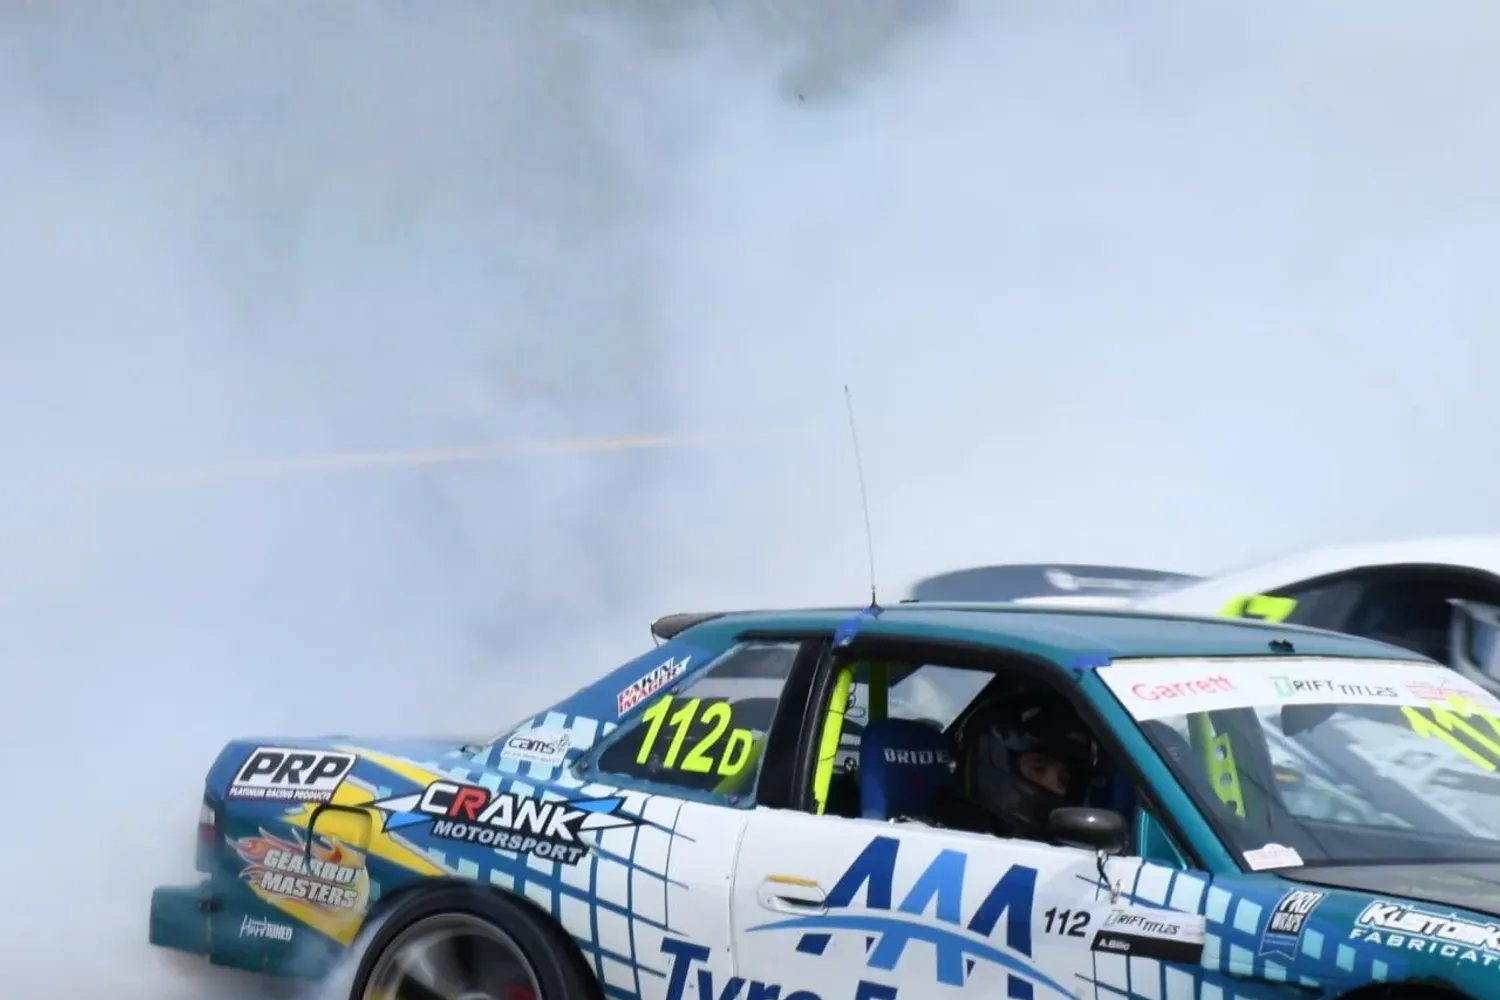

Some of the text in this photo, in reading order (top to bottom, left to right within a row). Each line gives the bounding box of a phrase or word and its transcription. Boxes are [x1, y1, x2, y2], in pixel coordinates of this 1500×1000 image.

[1131, 674, 1236, 701] Garrett
[239, 752, 351, 785] PRP
[884, 747, 949, 765] BRIDE
[266, 789, 294, 800] RACING
[420, 783, 587, 842] CRANK
[433, 820, 582, 863] MOTORSPORT
[260, 871, 357, 907] MASTERS
[1279, 890, 1325, 914] PRO
[1044, 906, 1091, 938] 112
